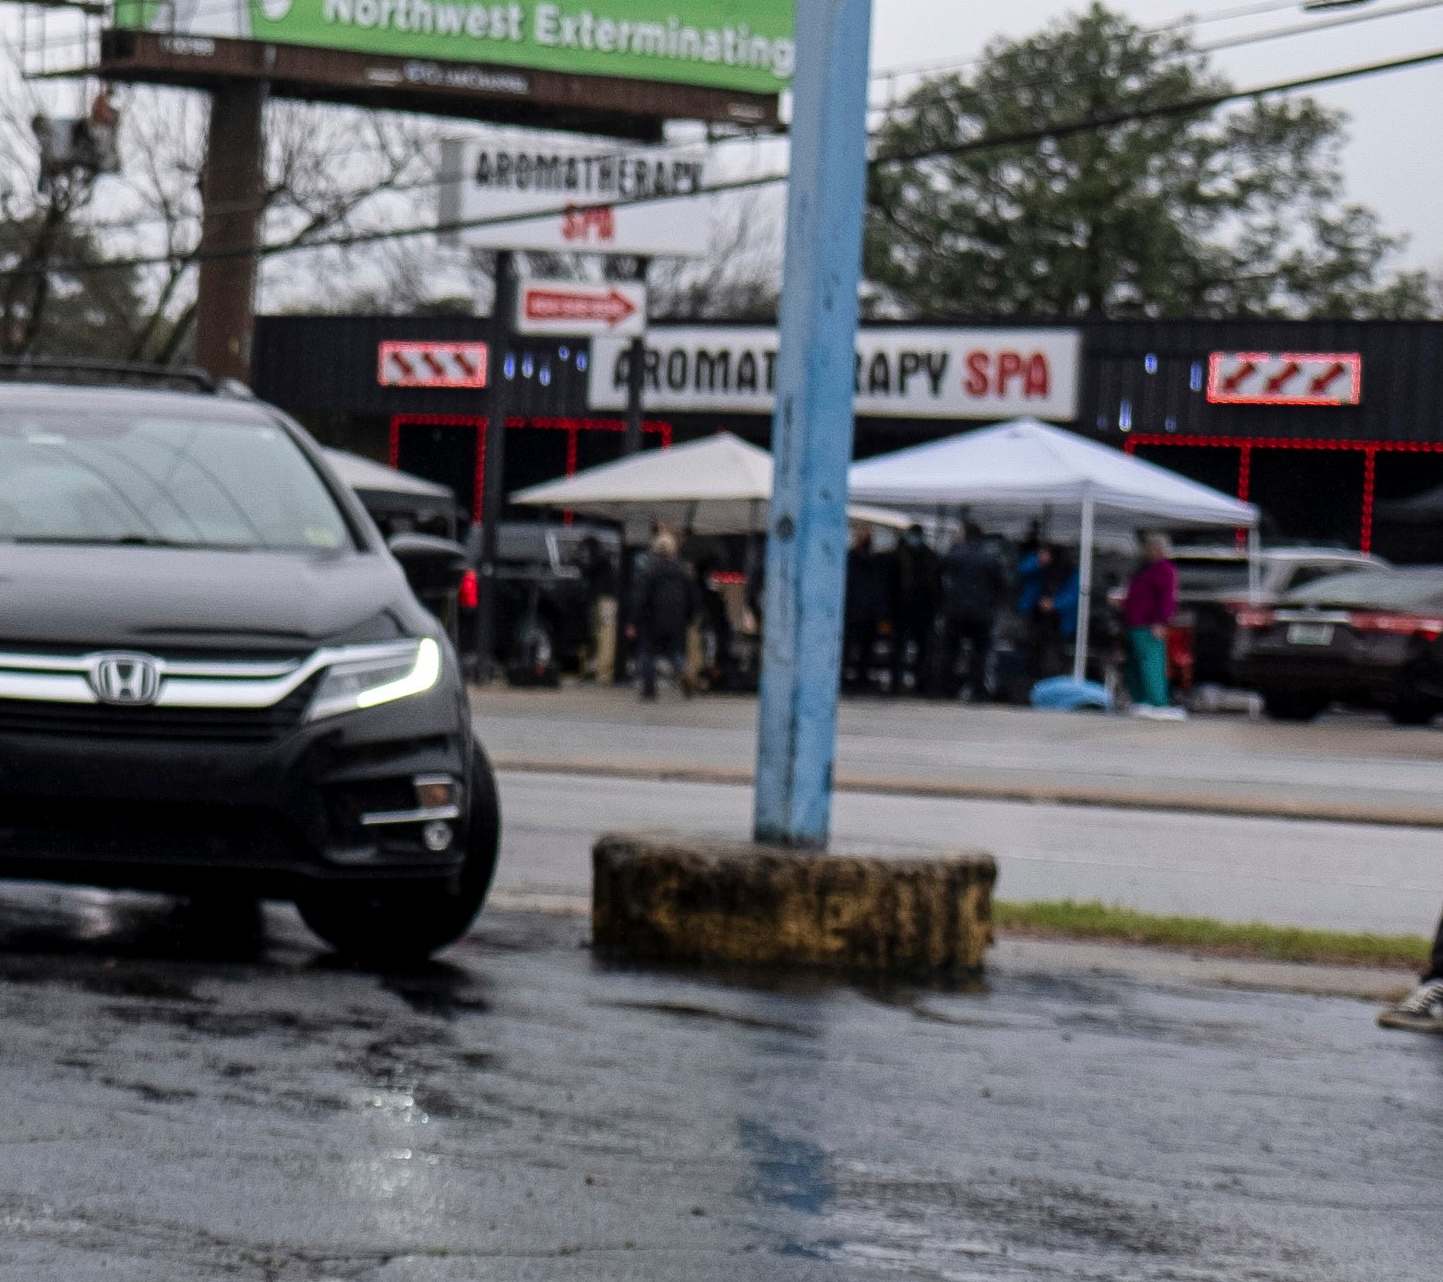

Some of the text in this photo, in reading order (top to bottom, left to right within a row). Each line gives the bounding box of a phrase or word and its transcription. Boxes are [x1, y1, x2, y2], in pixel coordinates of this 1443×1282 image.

[534, 3, 796, 80] Exterminating
[475, 150, 703, 199] AROMATHERAPY
[963, 348, 1050, 399] SPA
